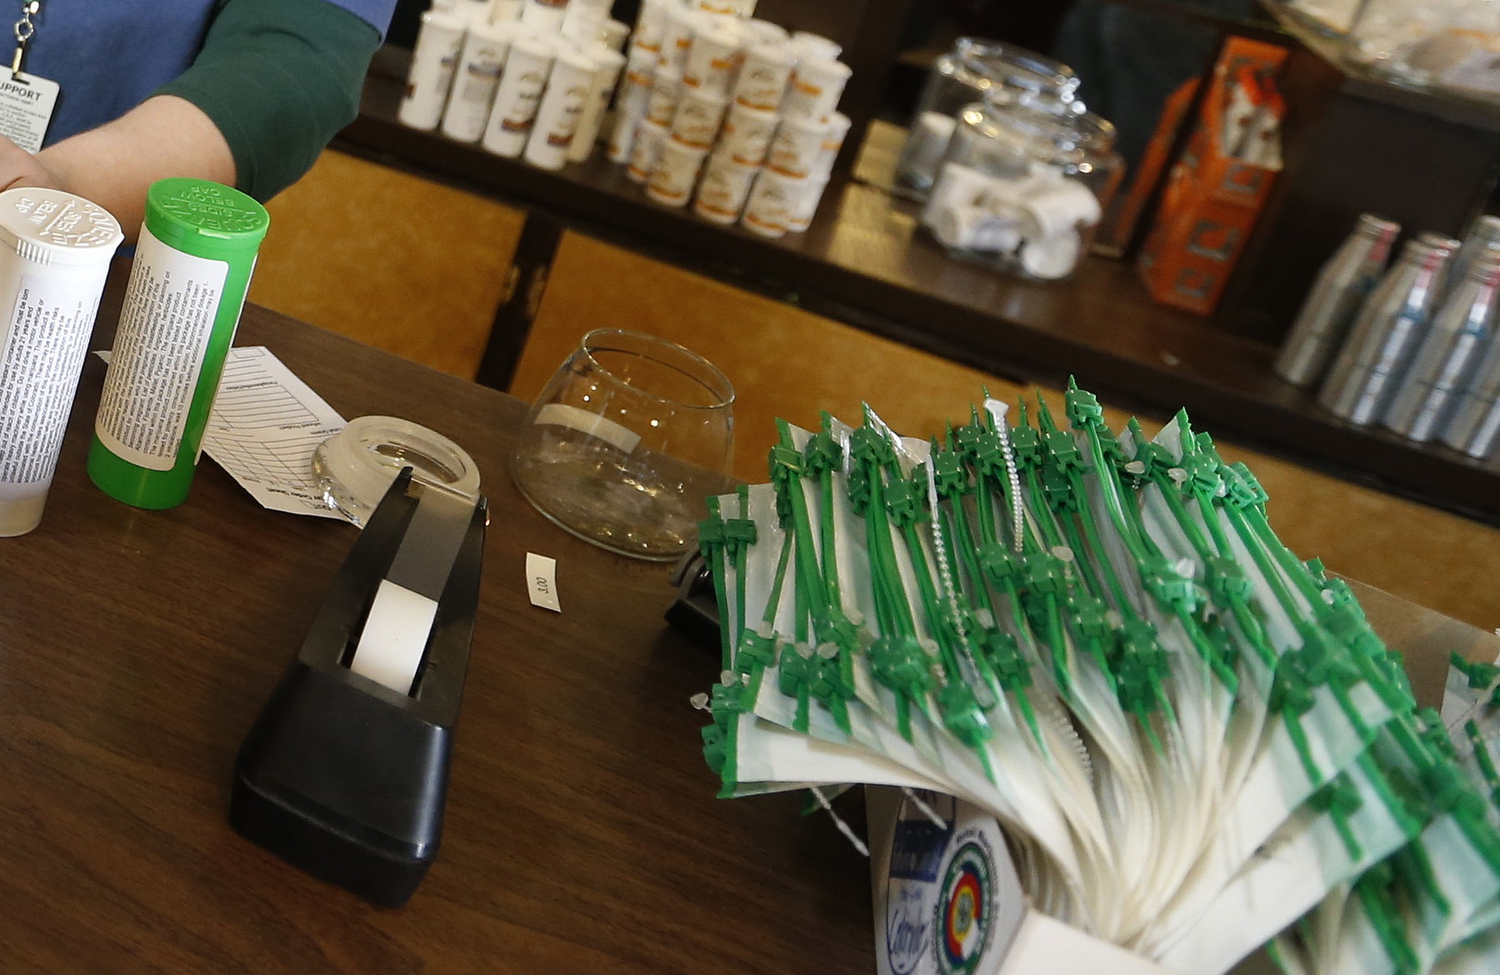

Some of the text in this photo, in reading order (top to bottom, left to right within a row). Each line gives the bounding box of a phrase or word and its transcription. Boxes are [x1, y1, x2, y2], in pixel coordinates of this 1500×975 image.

[25, 306, 33, 318] and
[4, 336, 16, 363] container
[11, 324, 19, 336] and
[15, 309, 23, 324] must
[21, 288, 29, 300] torn
[22, 318, 31, 335] years
[36, 316, 48, 339] product
[171, 325, 181, 342] tested
[13, 344, 23, 361] adults
[33, 338, 42, 352] This
[167, 342, 176, 357] been
[4, 416, 13, 432] reach
[21, 350, 30, 364] drive
[26, 327, 36, 344] motor
[31, 306, 41, 326] vehicle
[149, 283, 200, 455] The marijuana product contained within this package has not been
[157, 440, 166, 457] tested
[171, 385, 180, 409] consume
[176, 373, 184, 384] with
[186, 308, 201, 350] Recommended
[197, 287, 208, 308] dosage
[21, 382, 31, 398] using
[156, 378, 167, 401] package
[0, 390, 11, 415] intended
[17, 399, 26, 414] while
[9, 414, 23, 444] machinery
[149, 412, 158, 427] within
[142, 428, 153, 453] contained
[5, 444, 15, 461] heavy
[0, 461, 11, 482] operate
